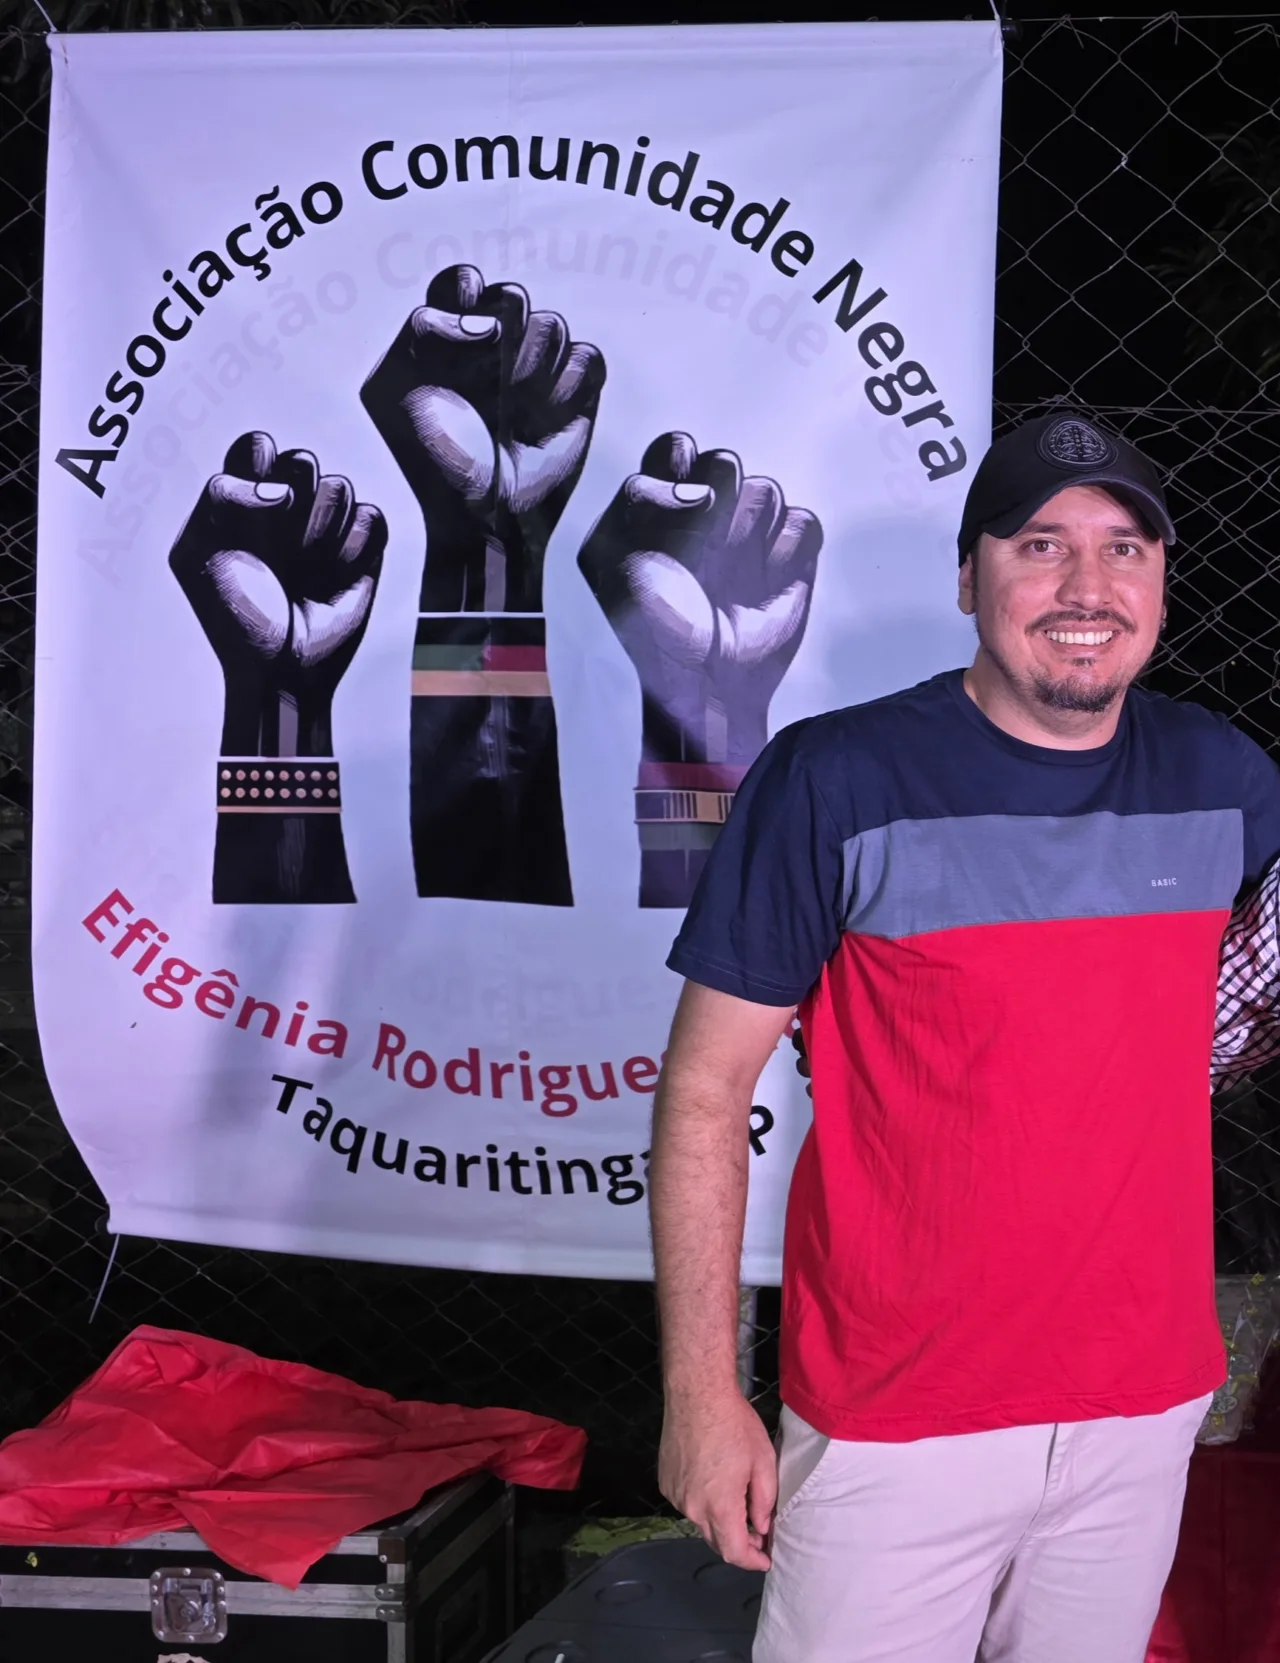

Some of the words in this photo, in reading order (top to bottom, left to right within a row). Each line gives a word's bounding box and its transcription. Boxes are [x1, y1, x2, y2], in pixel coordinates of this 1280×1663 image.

[55, 180, 344, 499] Associação
[361, 134, 816, 278] Comunidade
[812, 258, 968, 483] Negra
[1150, 877, 1177, 887] BASIC
[82, 888, 348, 1059] Efigênia
[372, 1023, 668, 1118] Rodrigue
